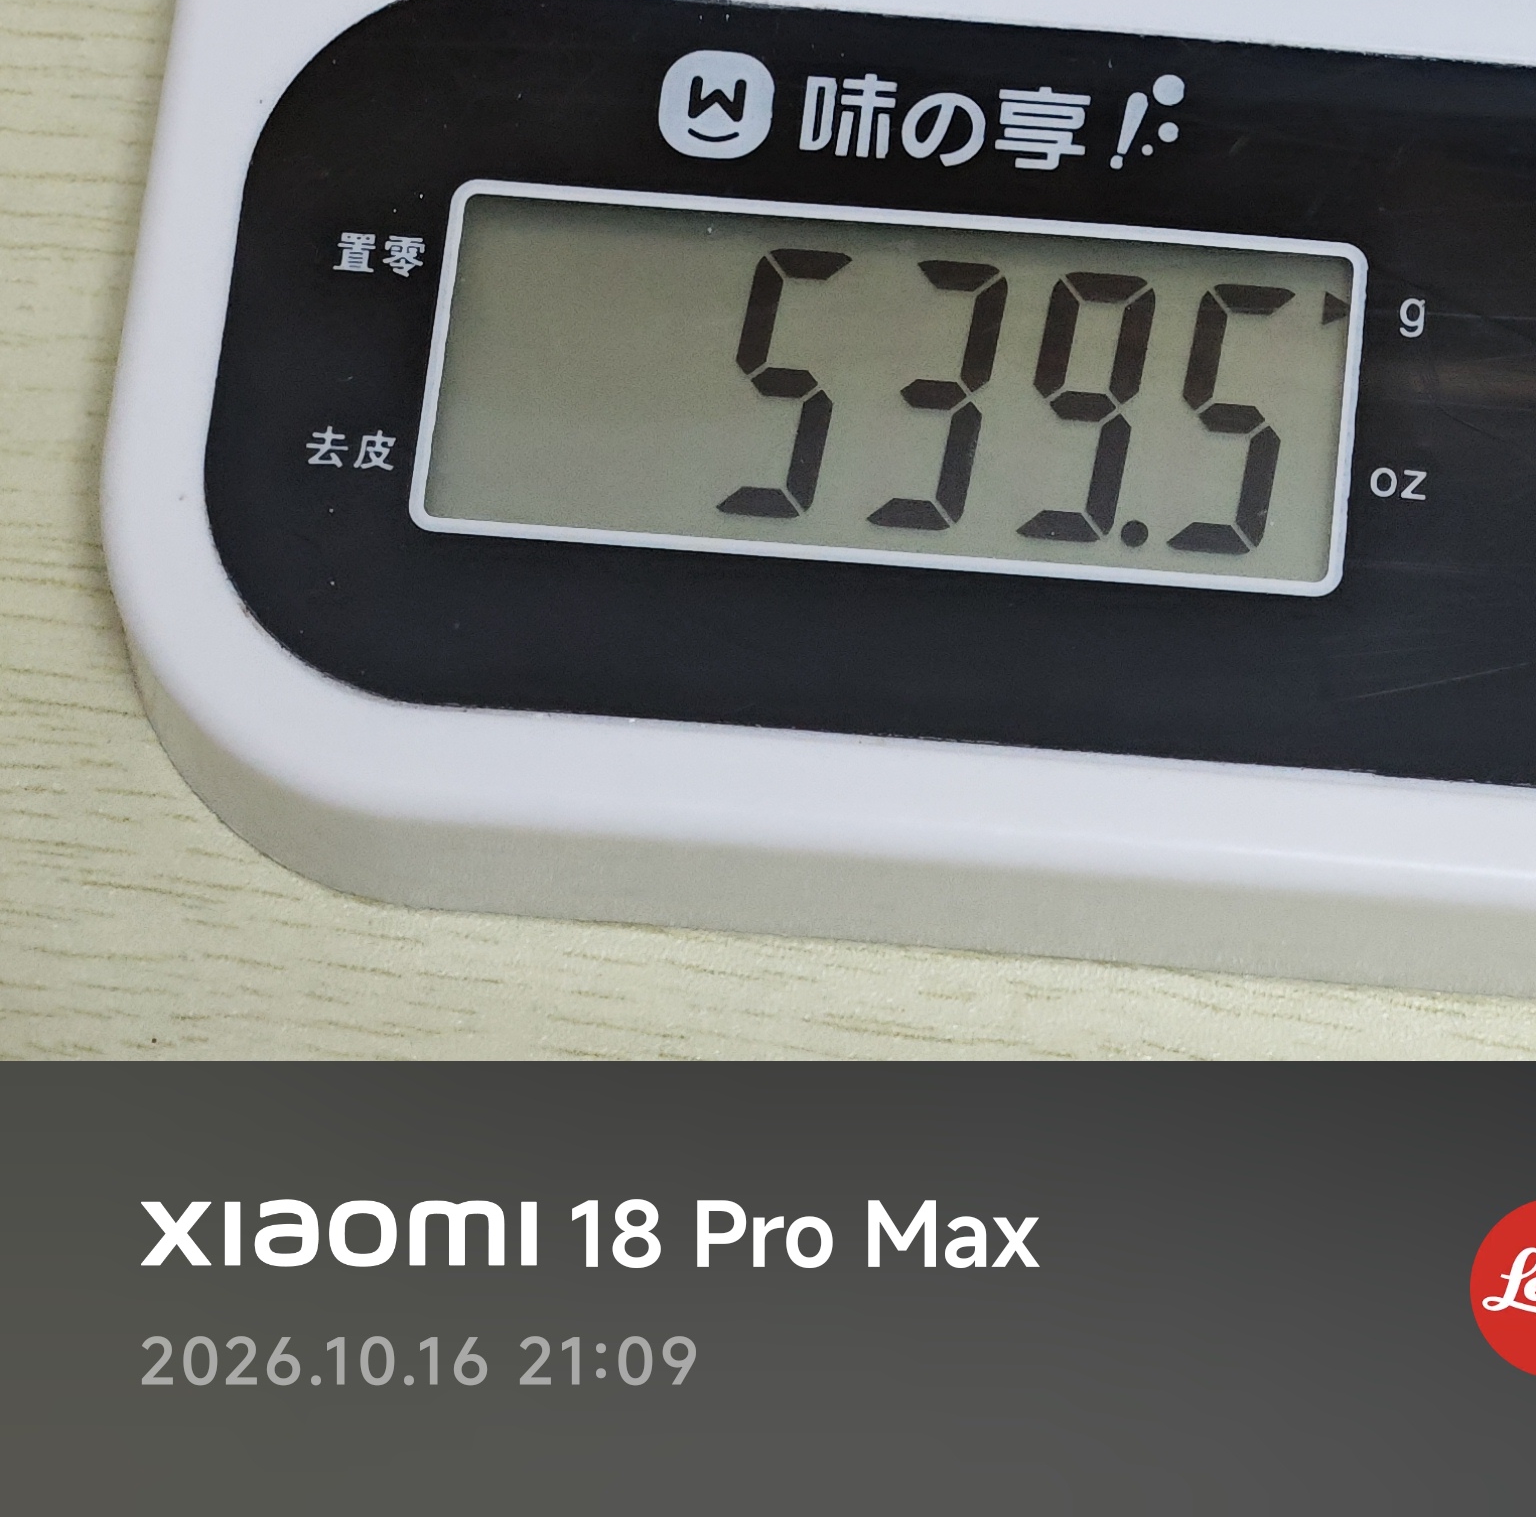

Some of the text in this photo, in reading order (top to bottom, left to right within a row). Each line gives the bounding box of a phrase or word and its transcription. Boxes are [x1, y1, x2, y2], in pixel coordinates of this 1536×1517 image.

[333, 232, 426, 278] 置零
[1400, 297, 1426, 338] g
[716, 248, 1296, 553] 539.5
[305, 425, 397, 471] 去皮
[1370, 467, 1427, 501] oz
